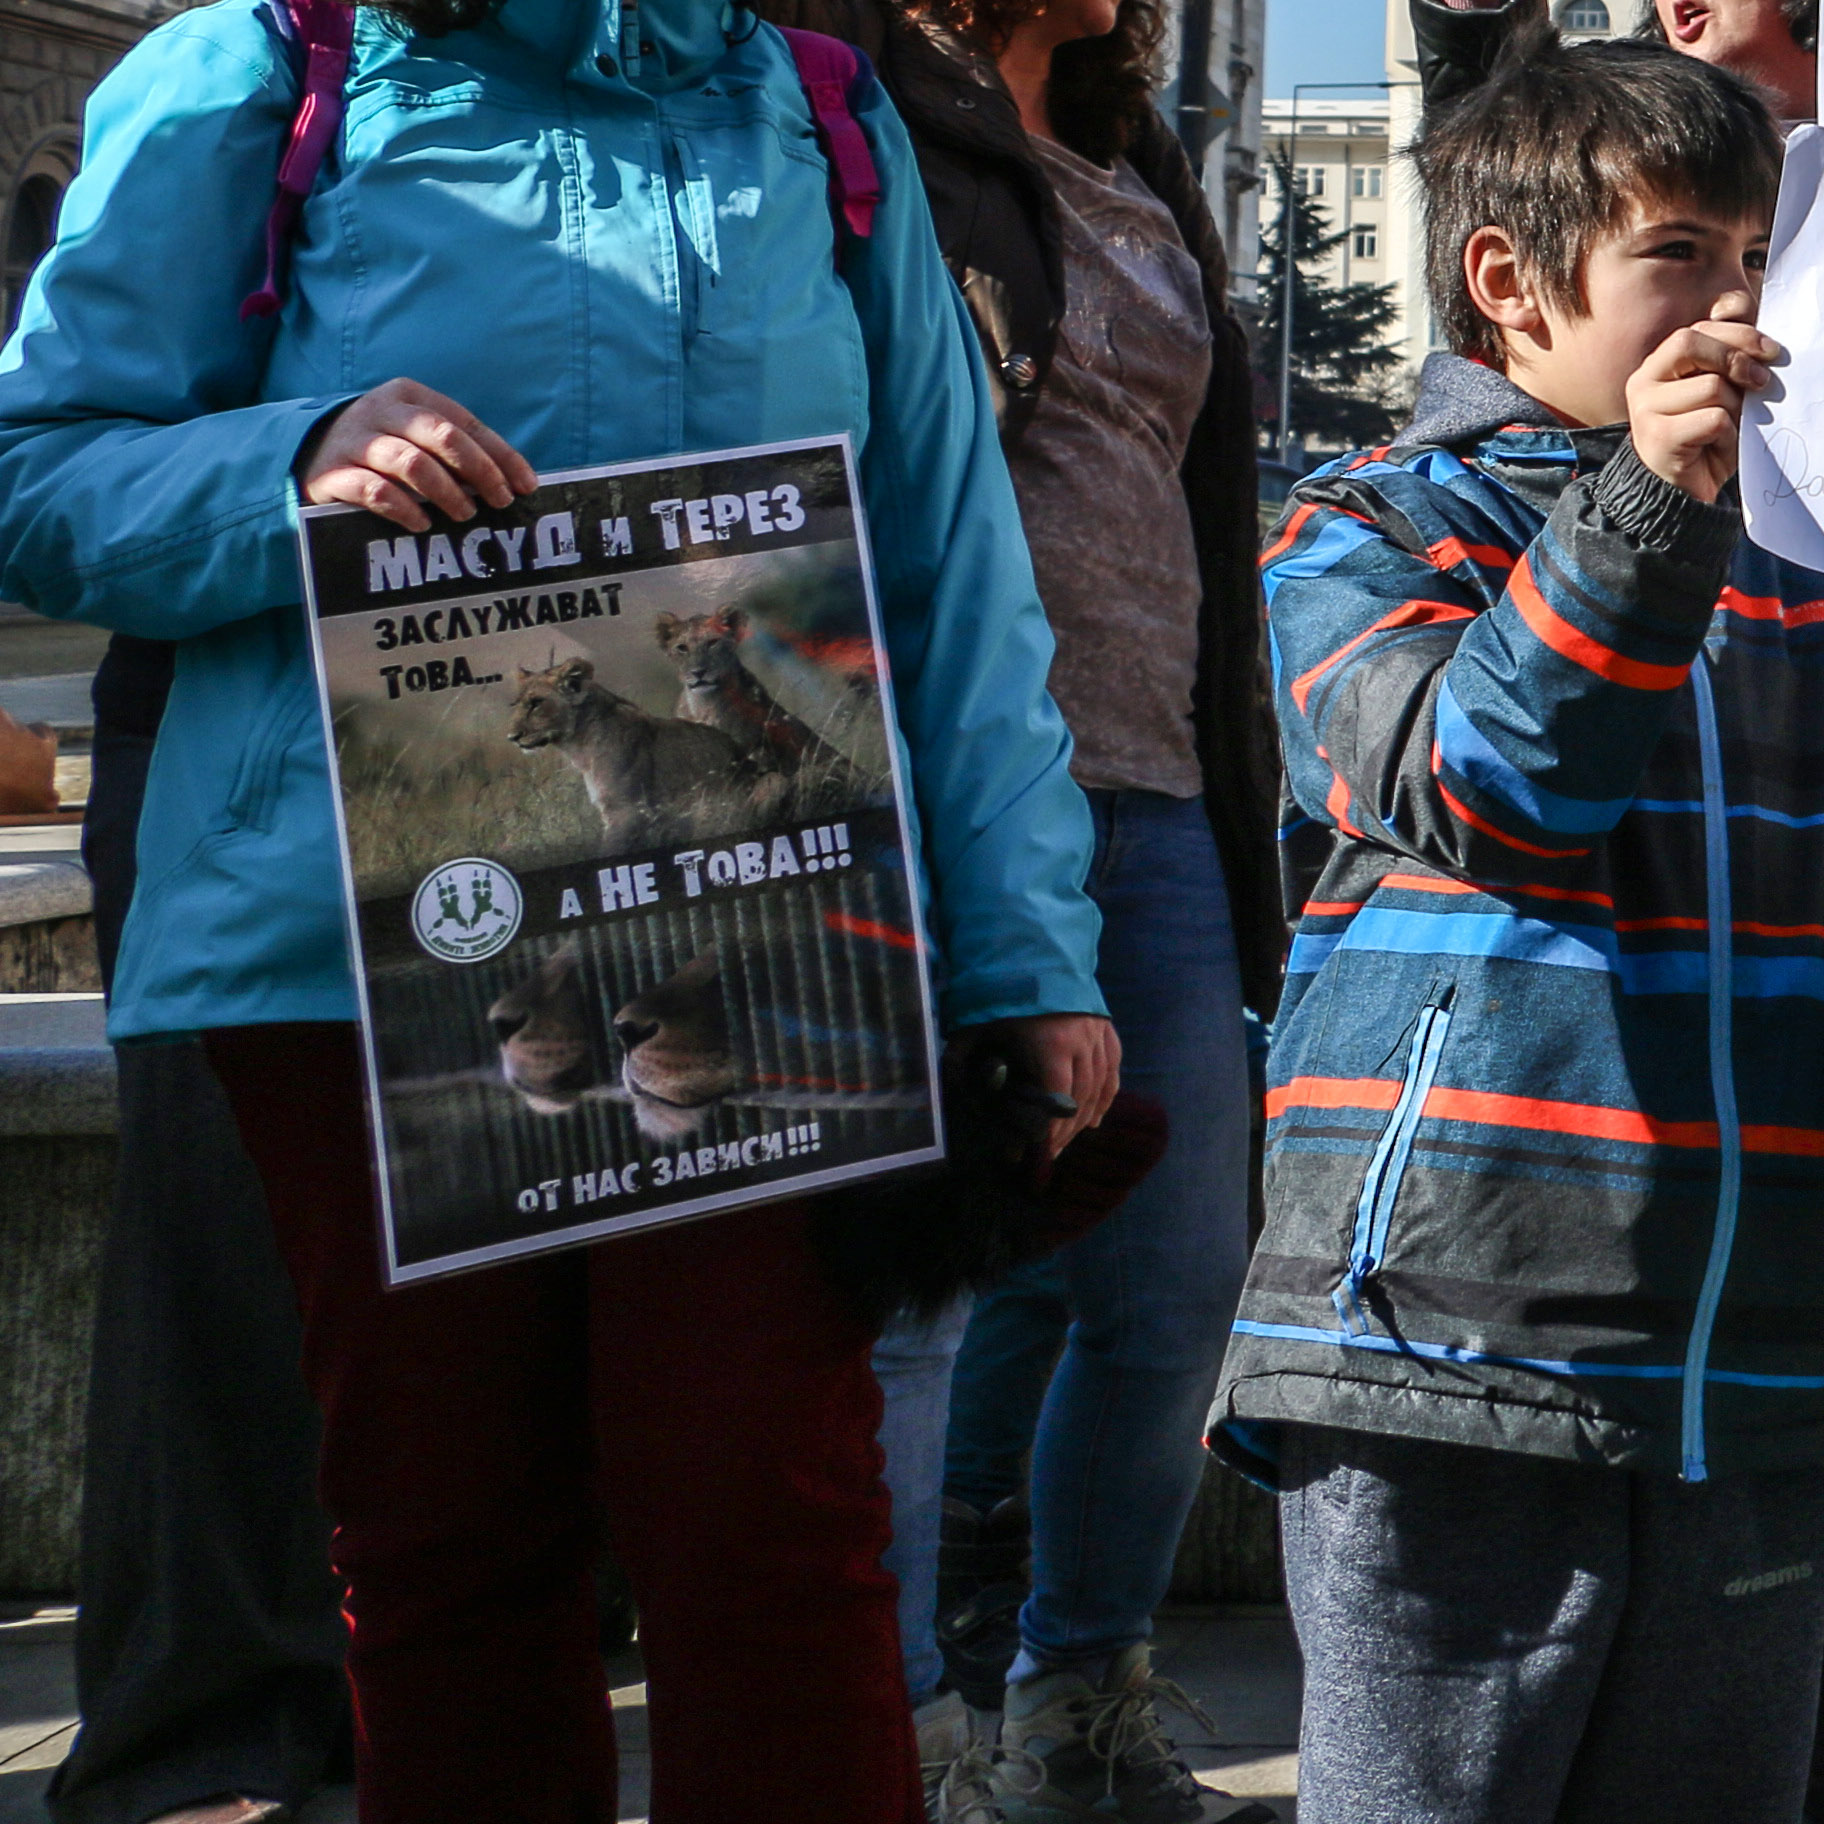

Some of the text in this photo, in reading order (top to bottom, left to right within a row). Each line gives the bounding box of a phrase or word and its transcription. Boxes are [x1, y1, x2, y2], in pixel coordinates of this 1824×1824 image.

[366, 510, 584, 593] МАСУД
[650, 482, 808, 553] ТЕРЕЗ
[373, 581, 625, 652] ЗАСЛУЖАВАТ
[379, 655, 504, 701] ТОВА...
[598, 861, 660, 914] НЕ
[674, 821, 853, 900] ТОВА!!!
[572, 1160, 643, 1205] НАС
[651, 1121, 822, 1187] ЗАВИСИ!!!
